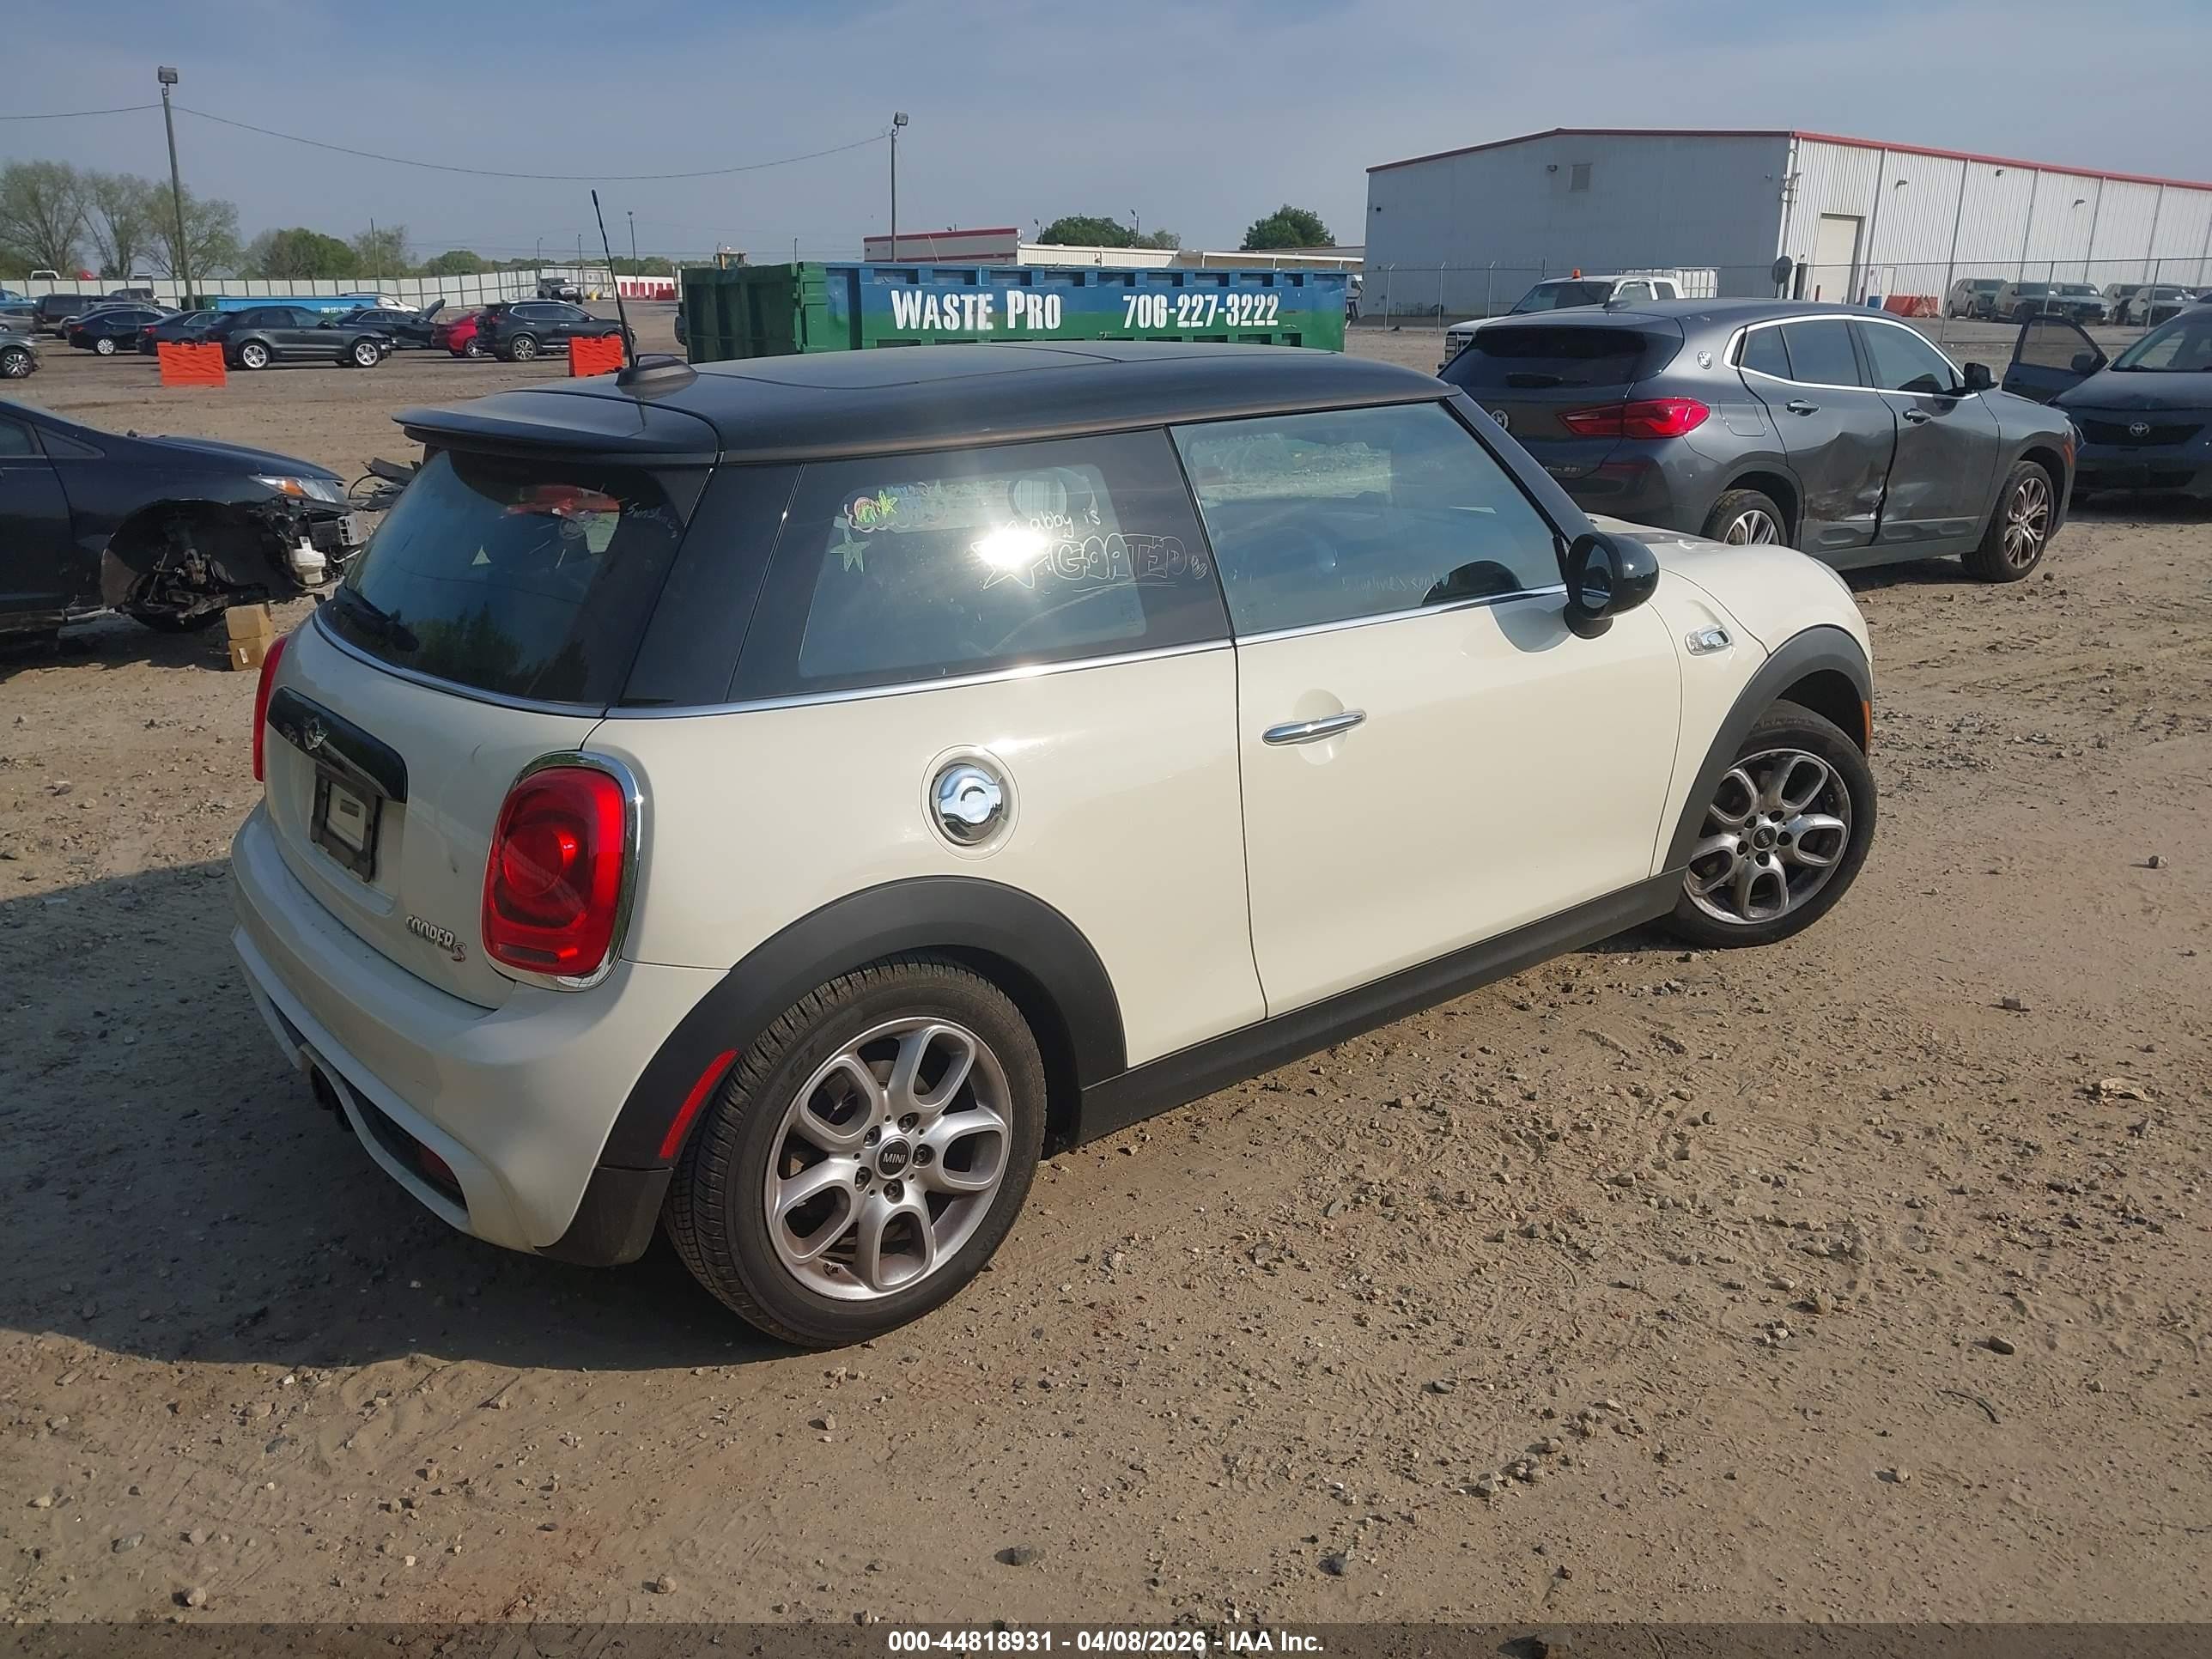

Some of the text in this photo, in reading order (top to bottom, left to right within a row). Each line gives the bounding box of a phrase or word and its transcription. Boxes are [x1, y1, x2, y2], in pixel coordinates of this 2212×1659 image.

[890, 289, 1061, 331] WASTE PRO
[1122, 293, 1279, 329] 706-227-3222
[1030, 508, 1101, 538] abby is
[1049, 533, 1187, 580] GOATED
[883, 1152, 906, 1164] MINI
